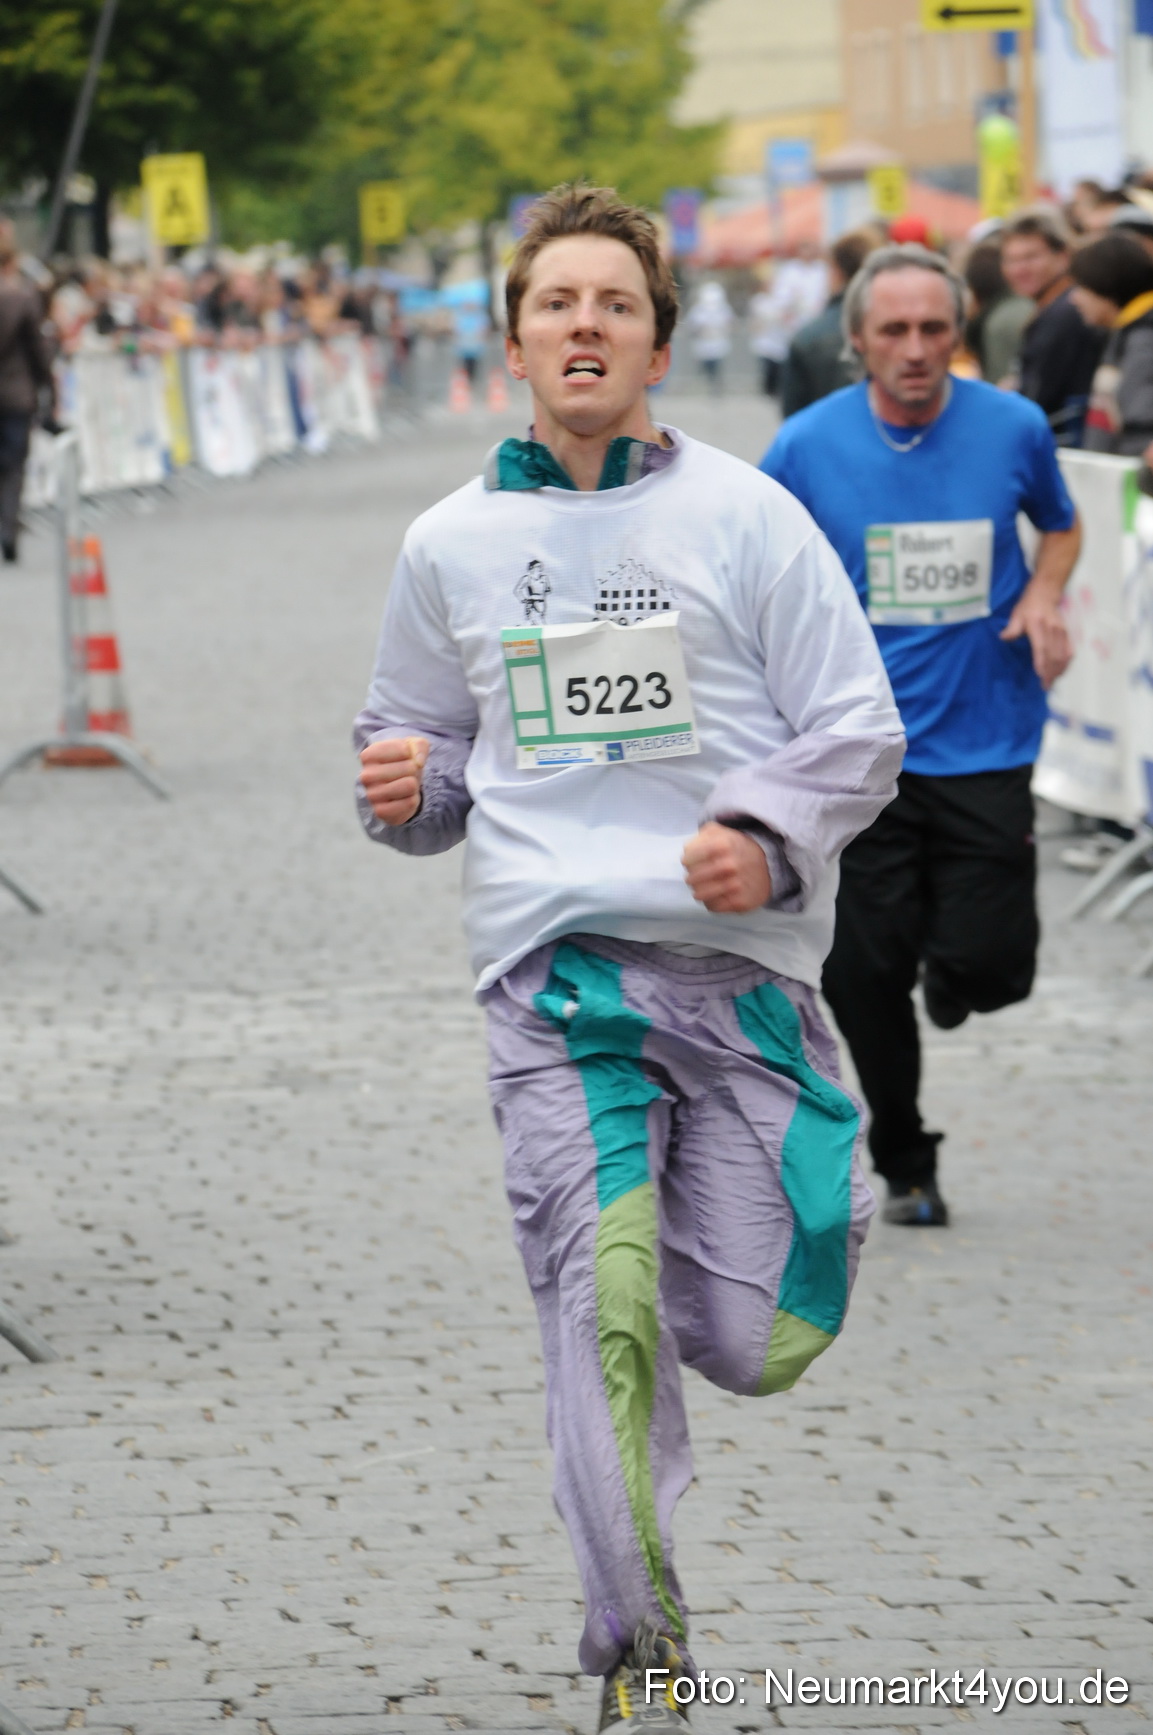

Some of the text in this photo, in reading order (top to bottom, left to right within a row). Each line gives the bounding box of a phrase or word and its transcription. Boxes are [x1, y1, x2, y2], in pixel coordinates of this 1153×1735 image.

[904, 561, 979, 592] 5098
[567, 671, 672, 716] 5223
[625, 732, 695, 751] PFLEIDERER
